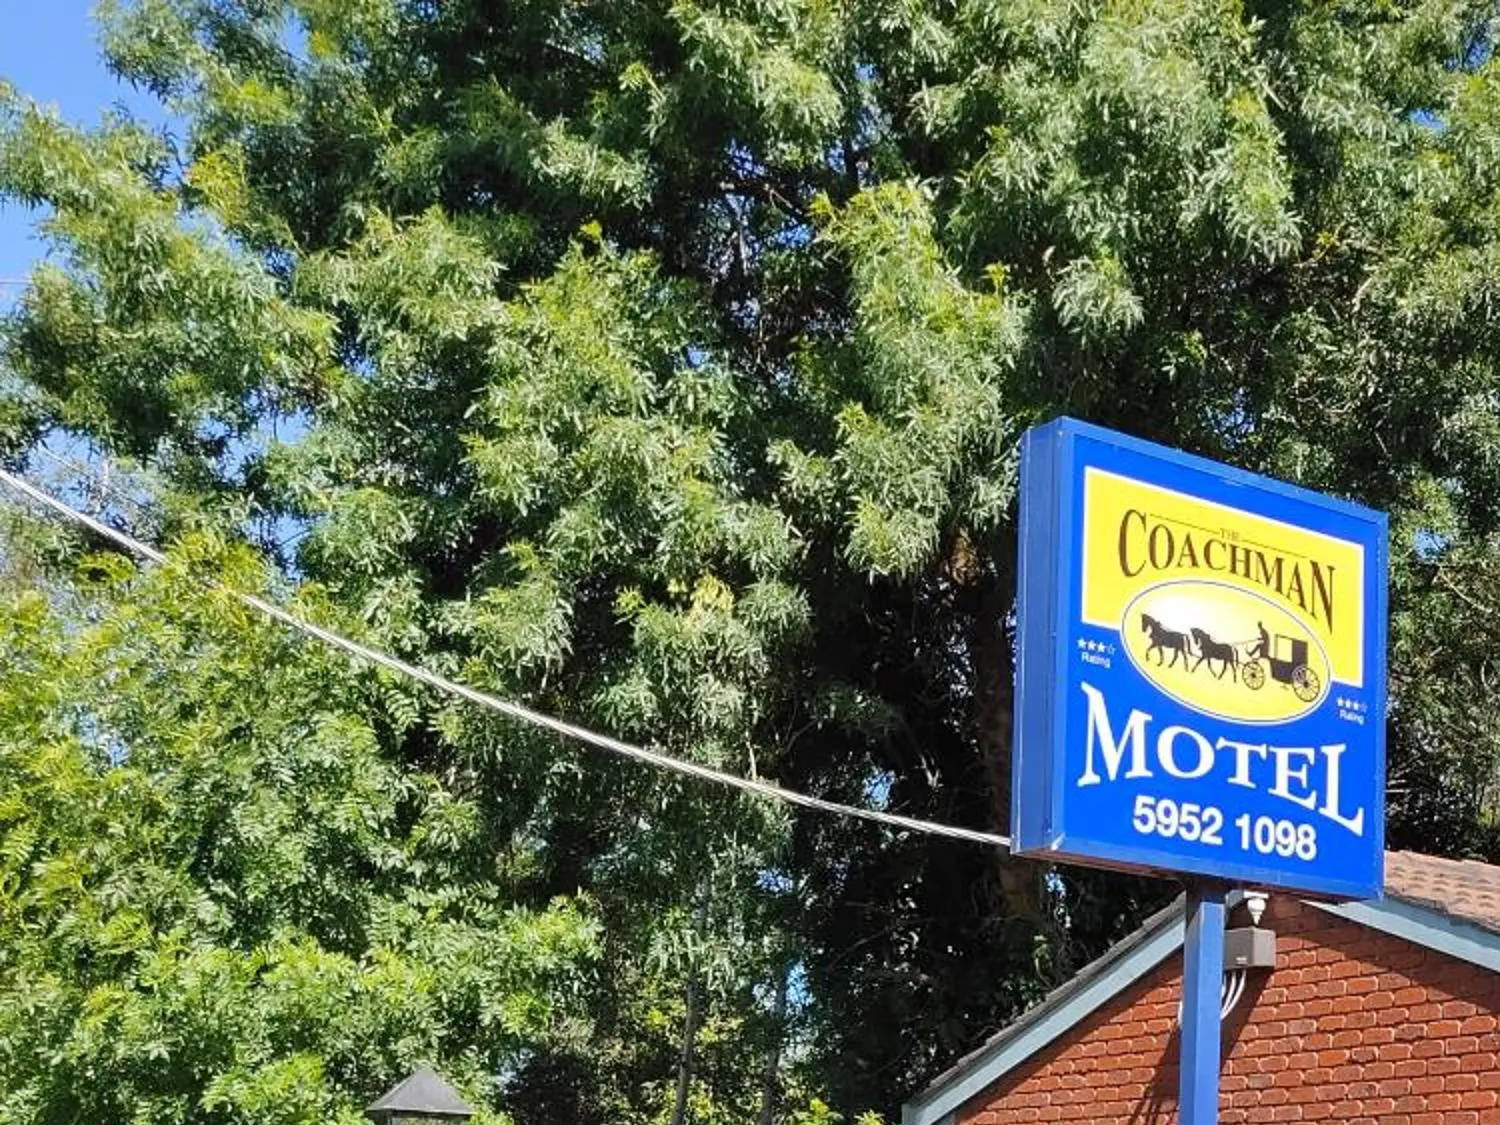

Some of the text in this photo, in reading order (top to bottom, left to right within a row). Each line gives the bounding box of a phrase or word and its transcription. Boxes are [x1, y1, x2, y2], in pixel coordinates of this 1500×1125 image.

[1118, 509, 1337, 635] COACHMAN
[1219, 527, 1241, 541] THE
[1077, 681, 1364, 837] MOTEL
[1133, 795, 1318, 861] 5952 1098
